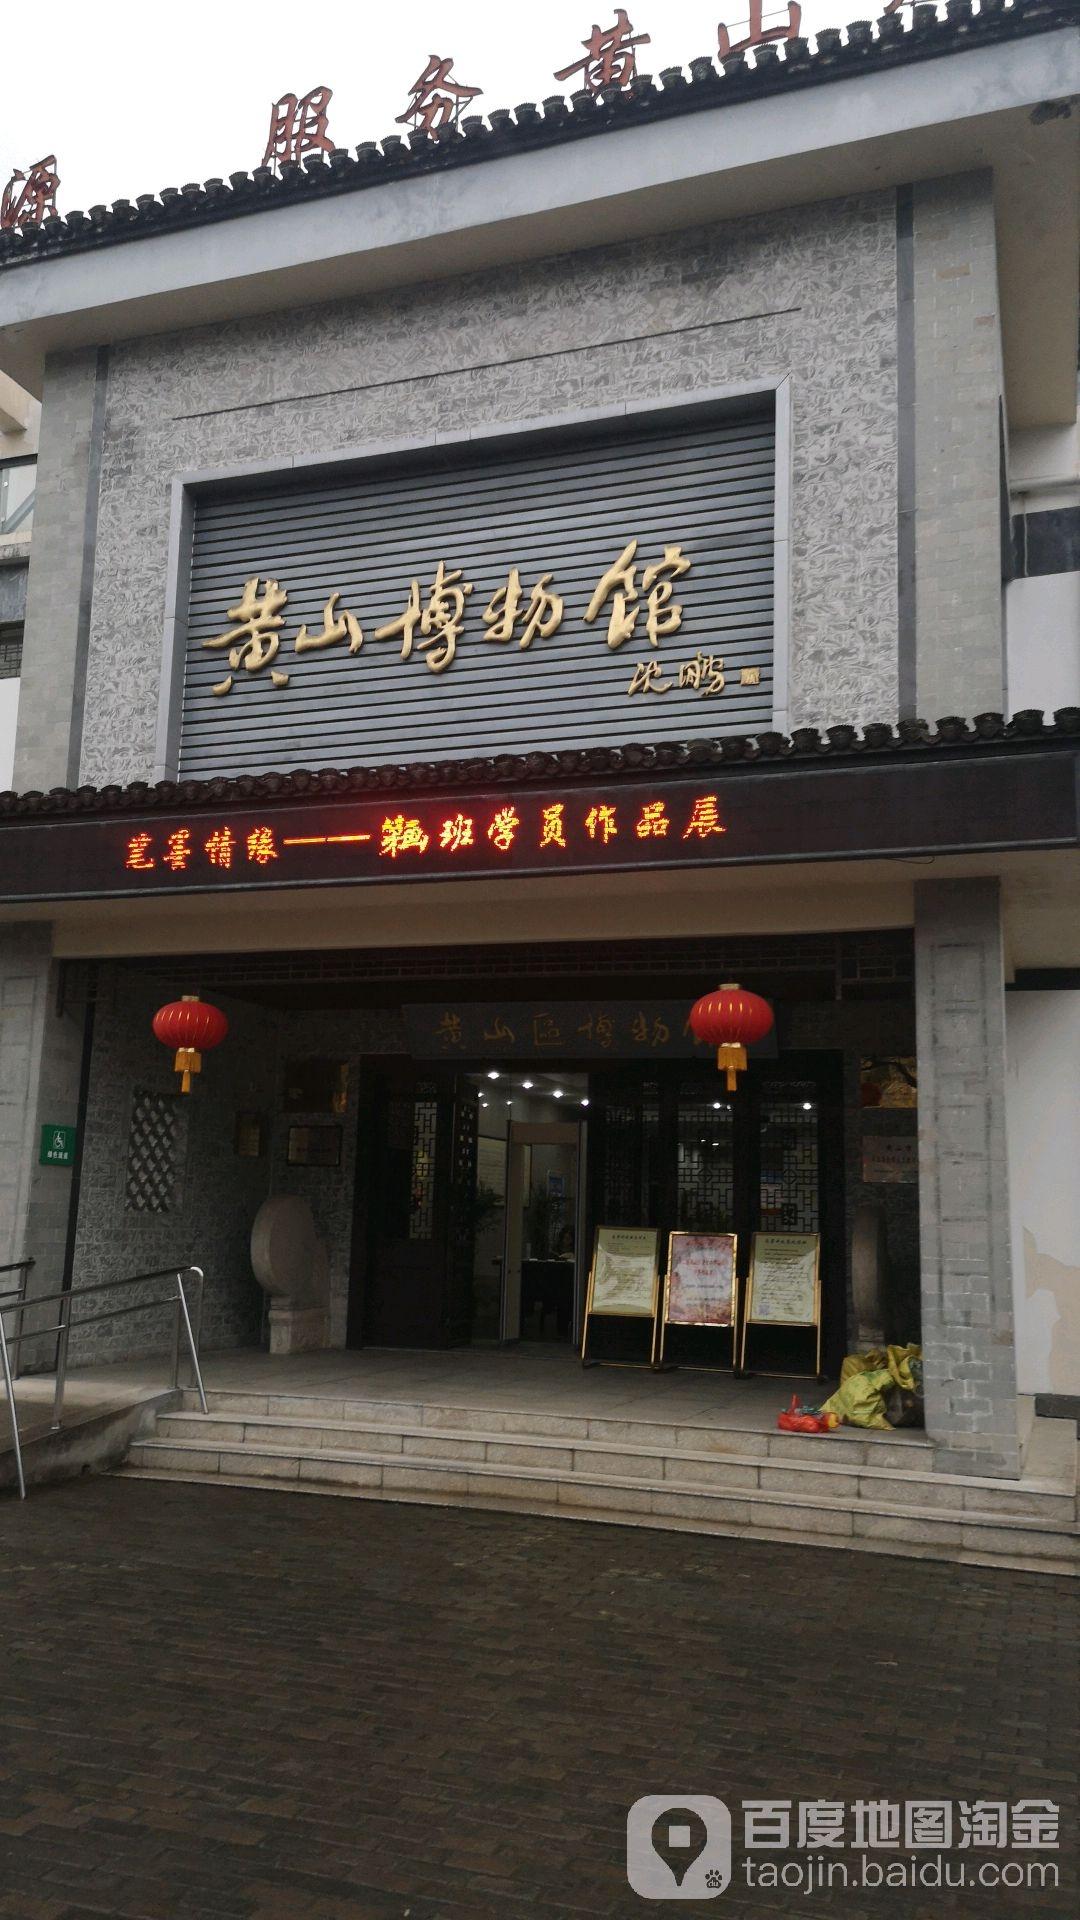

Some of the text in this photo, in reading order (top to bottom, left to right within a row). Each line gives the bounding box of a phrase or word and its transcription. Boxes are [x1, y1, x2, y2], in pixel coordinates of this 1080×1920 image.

[262, 0, 905, 167] 服务黄山
[202, 538, 693, 697] 黄山博物馆
